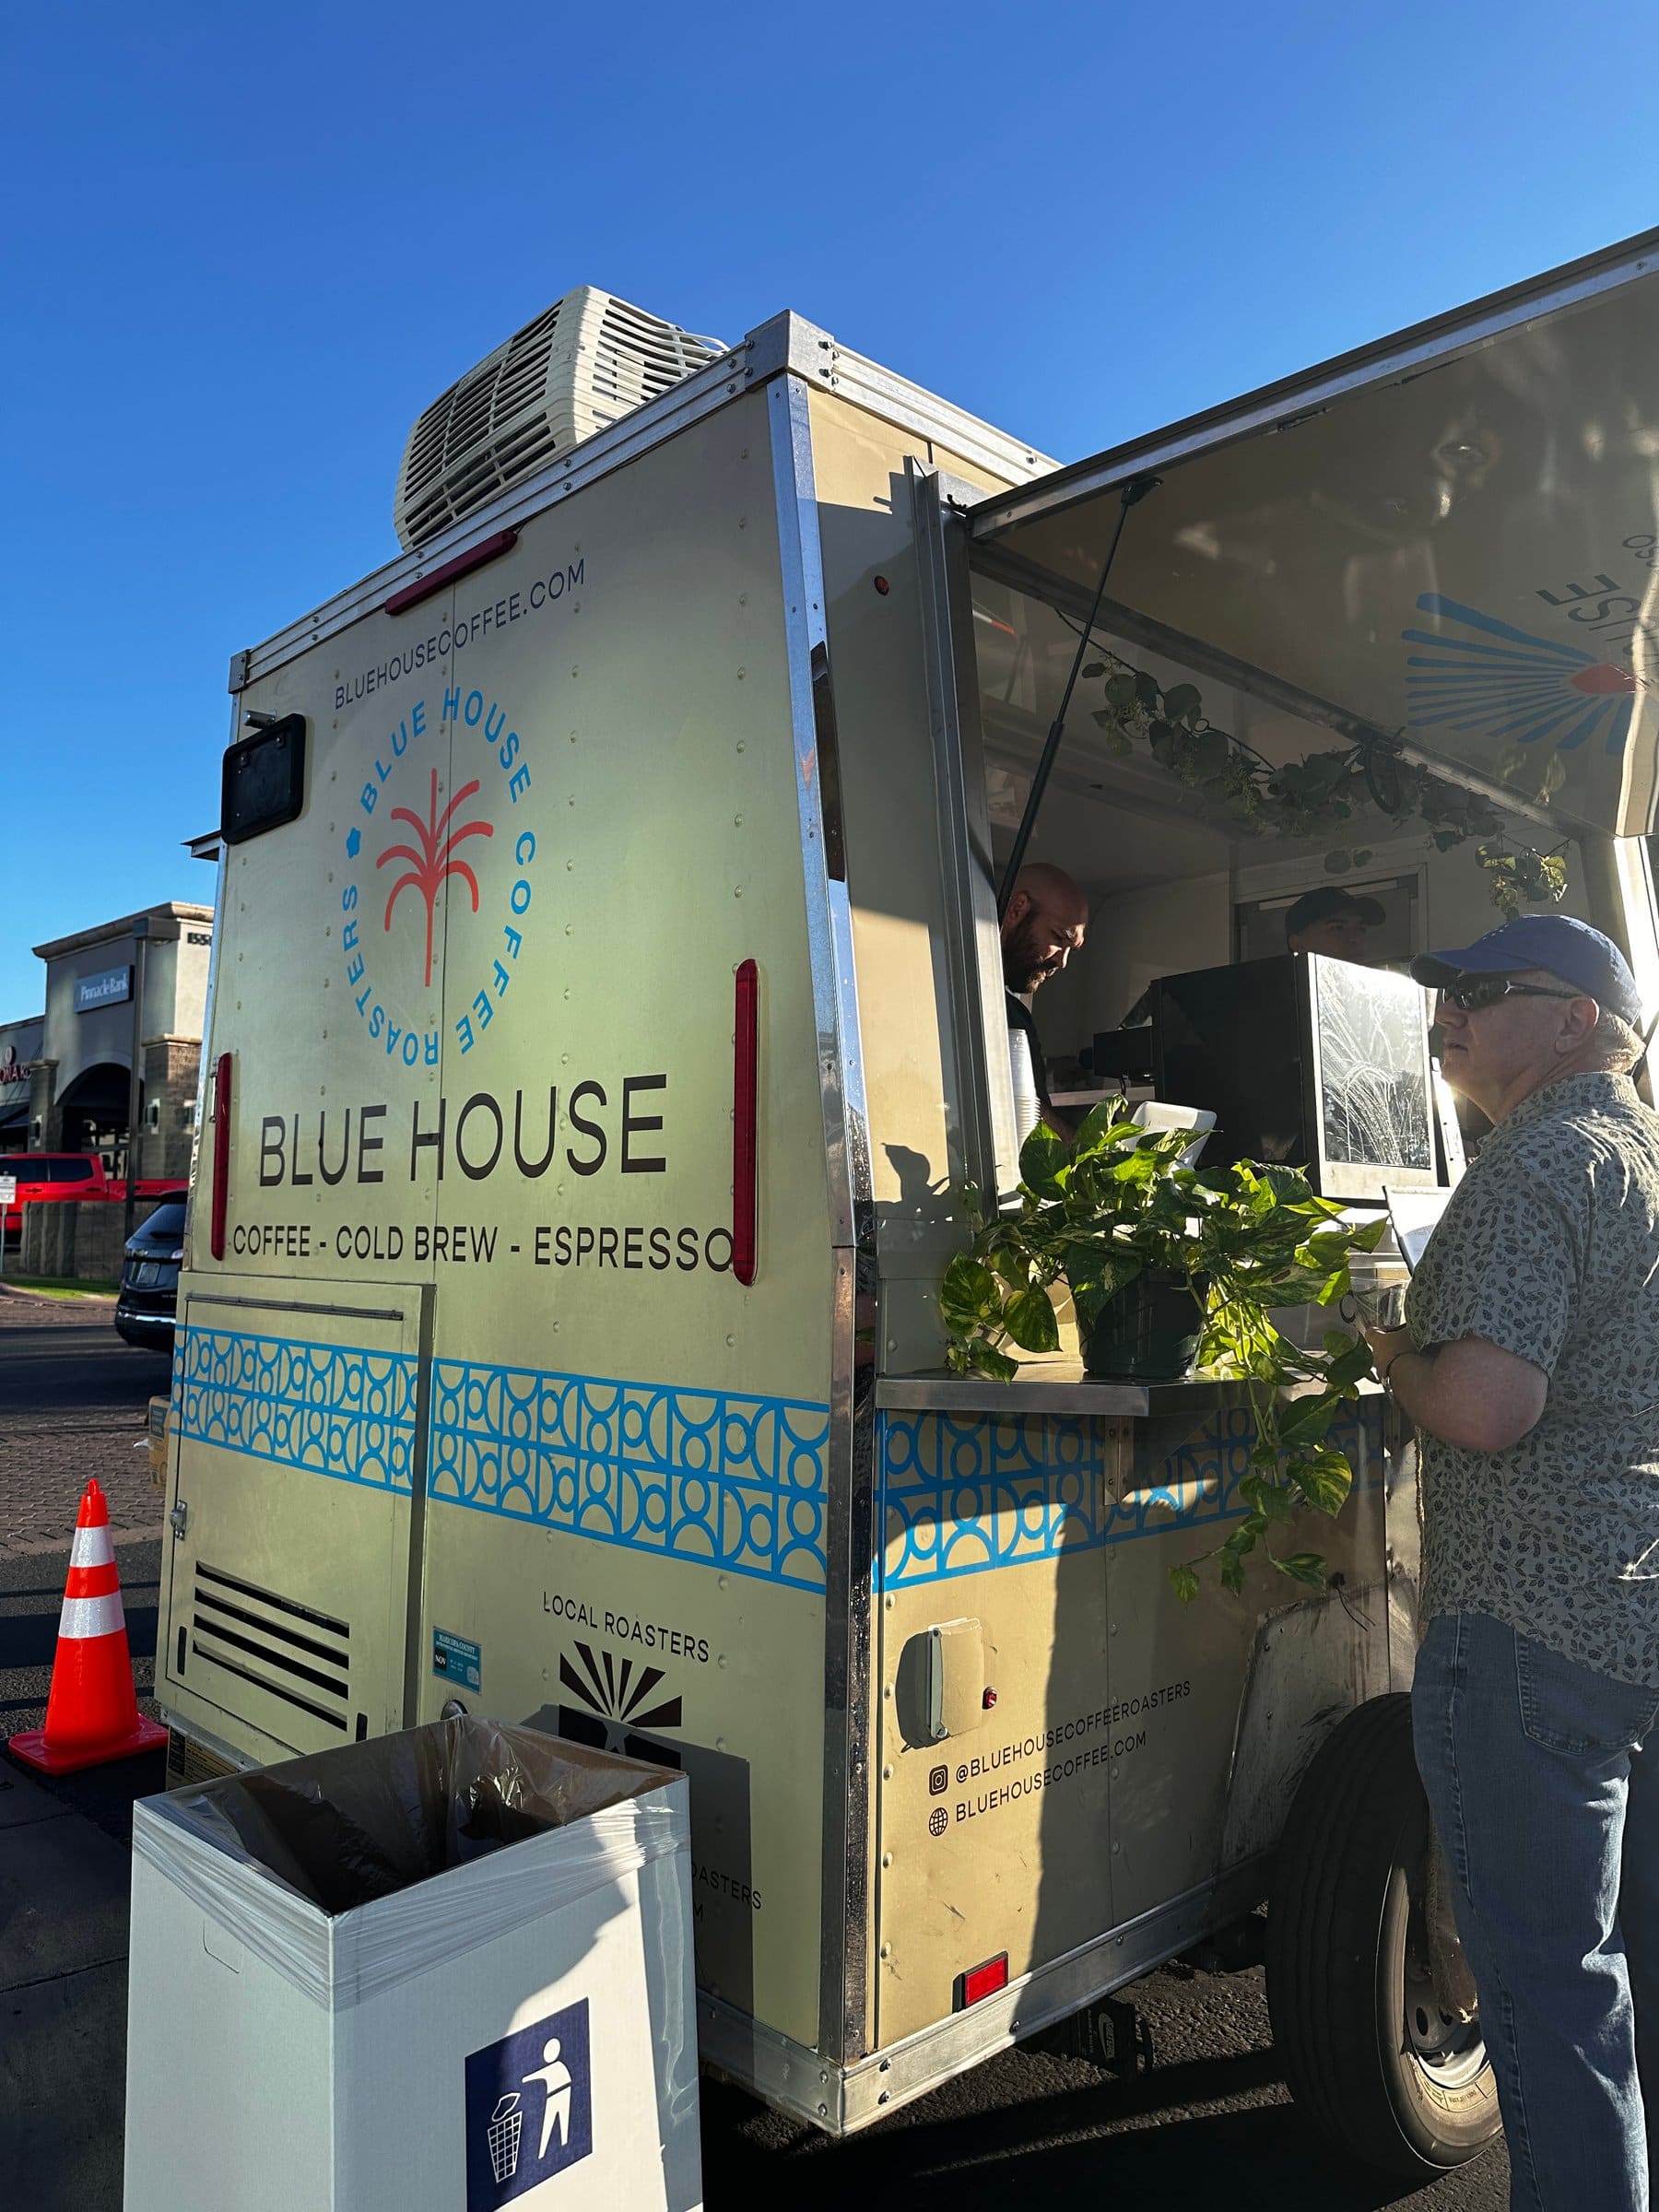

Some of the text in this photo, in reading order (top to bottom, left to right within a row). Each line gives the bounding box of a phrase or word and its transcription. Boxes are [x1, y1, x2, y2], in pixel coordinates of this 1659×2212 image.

[335, 558, 585, 710] BLUEHOUSECOFFEE.COM
[342, 687, 536, 1066] BLUE HOUSE COFFEE ROASTERS
[110, 973, 128, 994] Bank
[259, 1074, 667, 1187] BLUE HOUSE
[233, 1225, 311, 1256] COFFEE
[336, 1225, 404, 1260] COLD
[415, 1226, 498, 1263] BREW
[535, 1226, 734, 1273] ESPRESSO
[544, 1592, 709, 1663] LOCAL ROASTERS
[956, 1680, 1191, 1783] @BLUEHOUSECOFFEEROASTERS
[956, 1731, 1147, 1822] BLUEHOUSECOFFEE.COM
